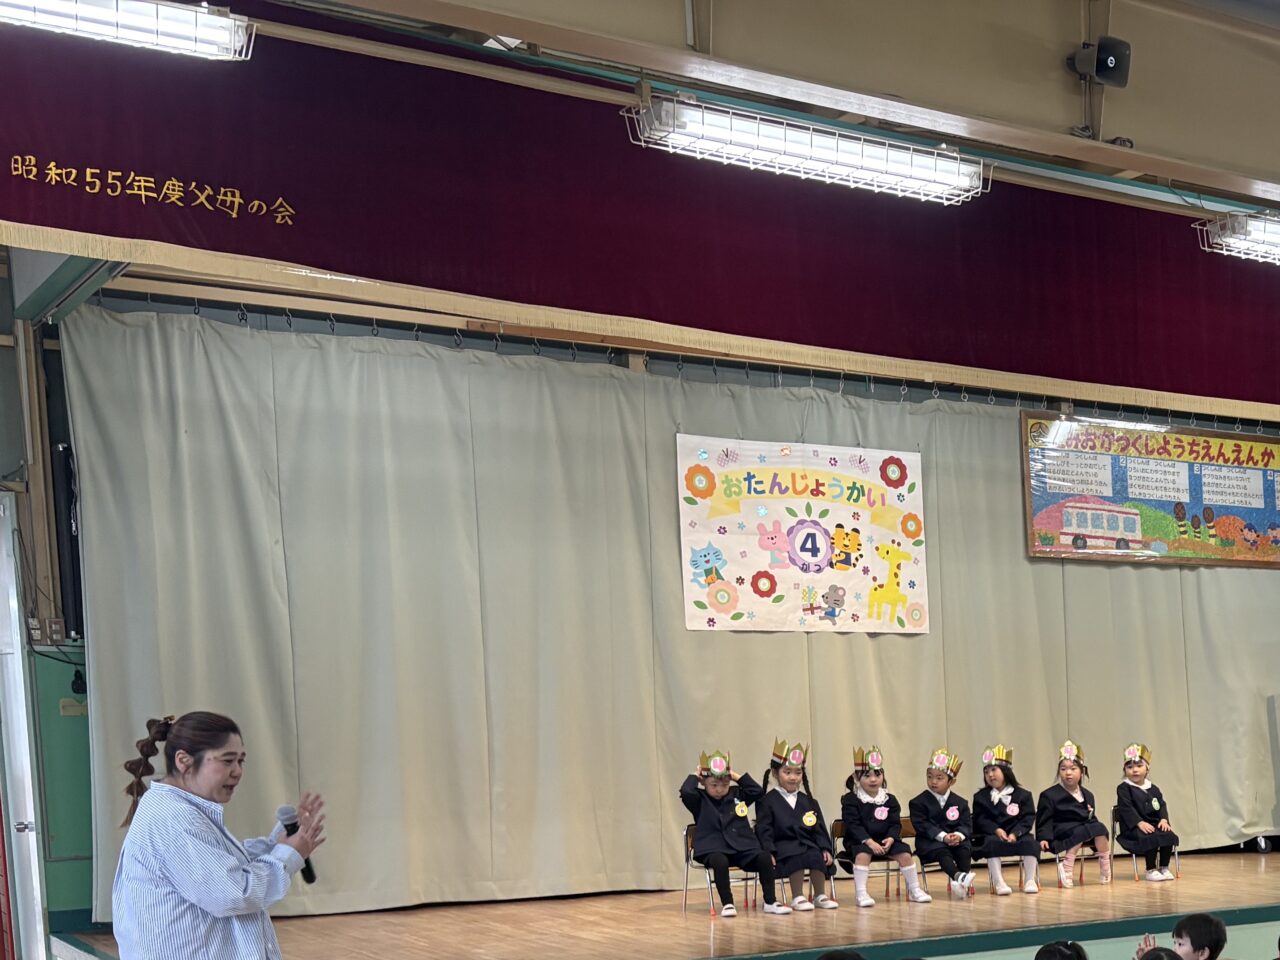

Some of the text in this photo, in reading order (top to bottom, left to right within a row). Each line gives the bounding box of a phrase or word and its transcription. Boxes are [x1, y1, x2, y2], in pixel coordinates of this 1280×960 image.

[11, 154, 297, 226] 昭和55年度父母の会
[1120, 457, 1126, 465] 2
[721, 471, 887, 509] おたんじょうかい
[800, 532, 821, 558] 4
